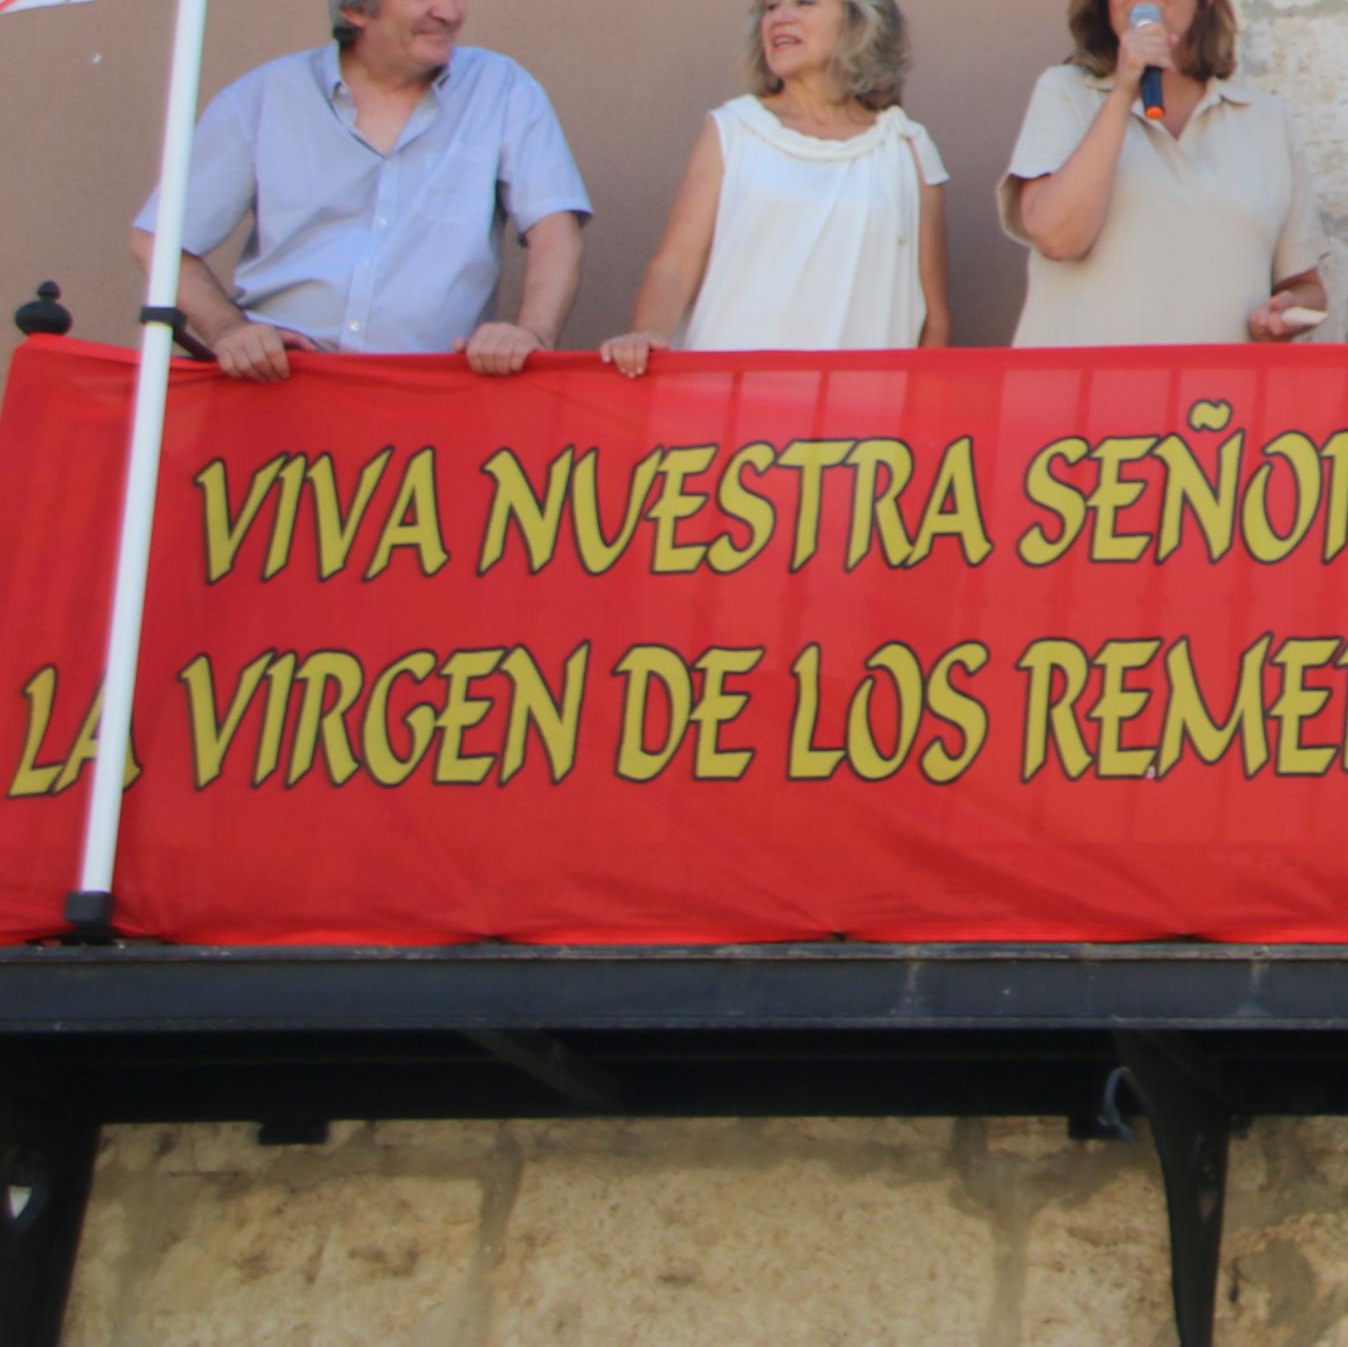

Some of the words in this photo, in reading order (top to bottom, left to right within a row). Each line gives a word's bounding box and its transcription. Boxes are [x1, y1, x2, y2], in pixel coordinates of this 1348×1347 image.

[194, 445, 450, 584] VIVA
[477, 435, 994, 576] NUESTRA
[6, 663, 144, 799] LA
[180, 639, 593, 790] VIRGEN
[612, 642, 765, 783] DE
[786, 640, 990, 785] LOS
